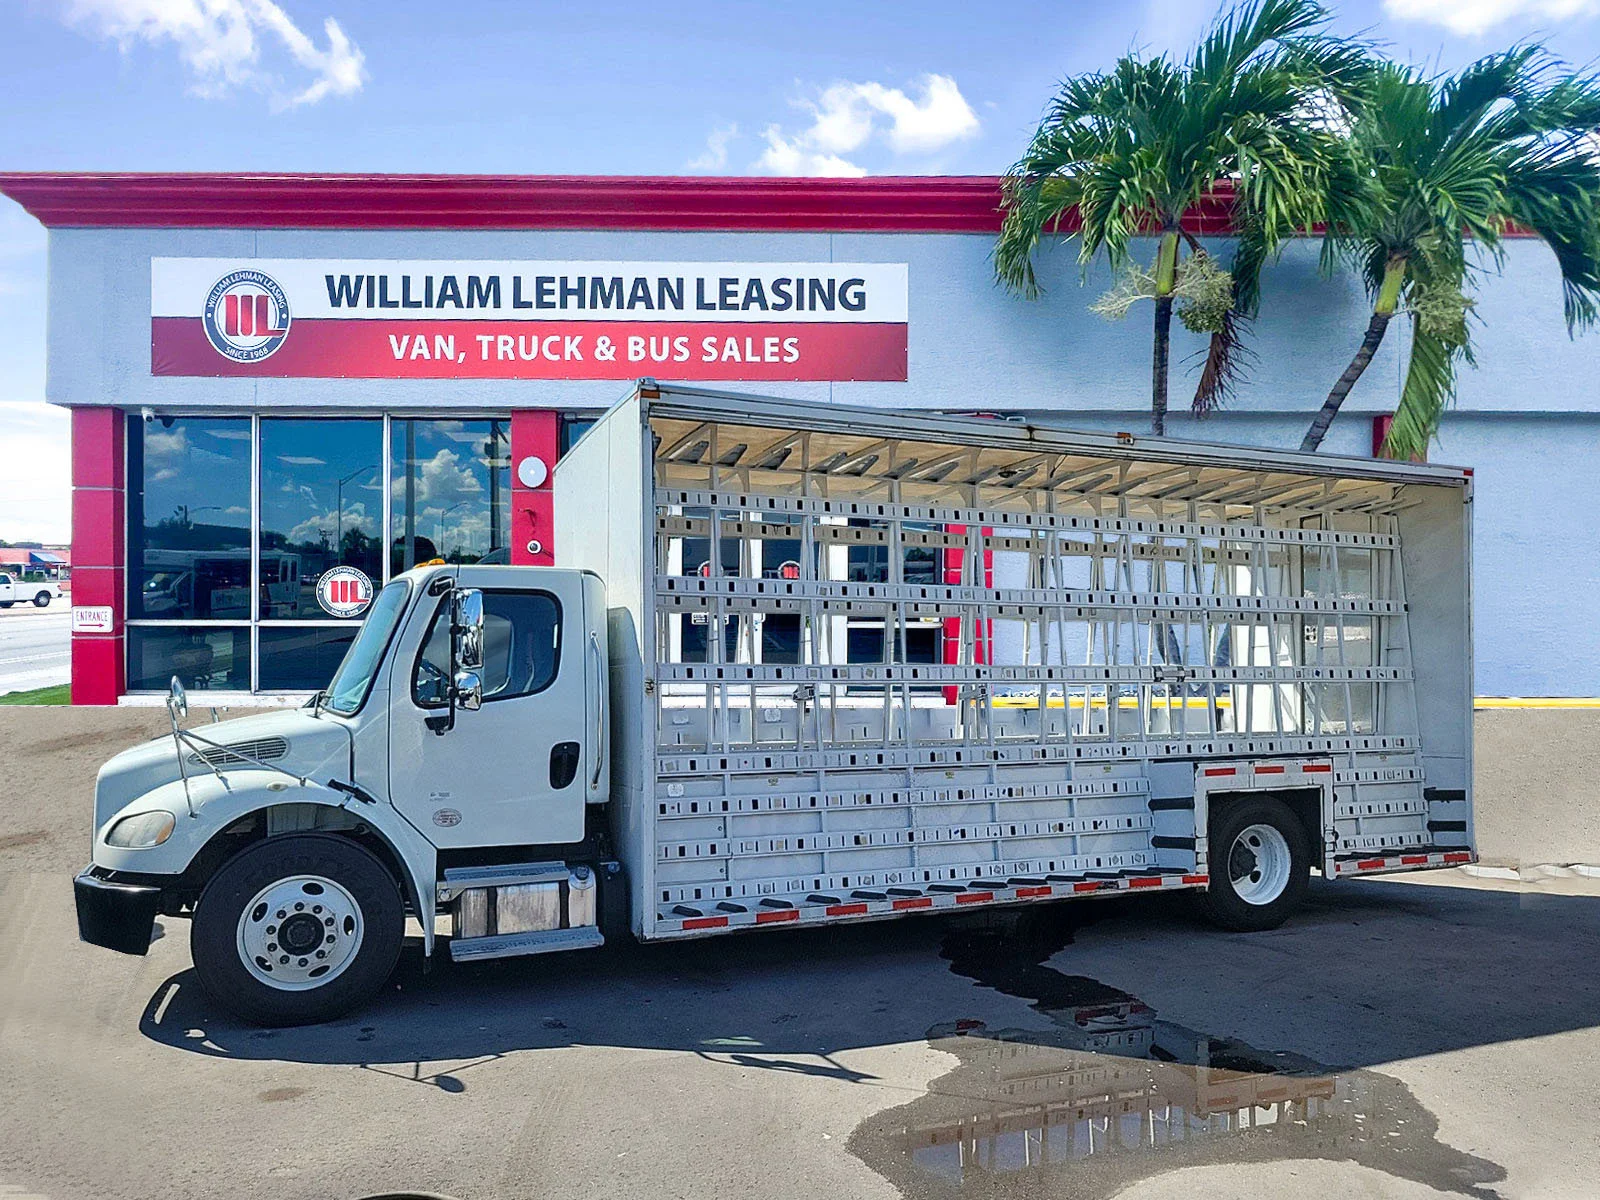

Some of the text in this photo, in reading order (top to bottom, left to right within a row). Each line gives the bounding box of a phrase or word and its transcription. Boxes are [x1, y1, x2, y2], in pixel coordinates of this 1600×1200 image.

[208, 272, 287, 309] WILLIAM LEHMAN LEASING
[324, 274, 866, 311] WILLIAM LEHMAN LEASING
[224, 346, 269, 359] SINCE 1968
[388, 334, 800, 363] VAN, TRUCK & BUS SALES
[76, 610, 108, 622] ENTRANCE
